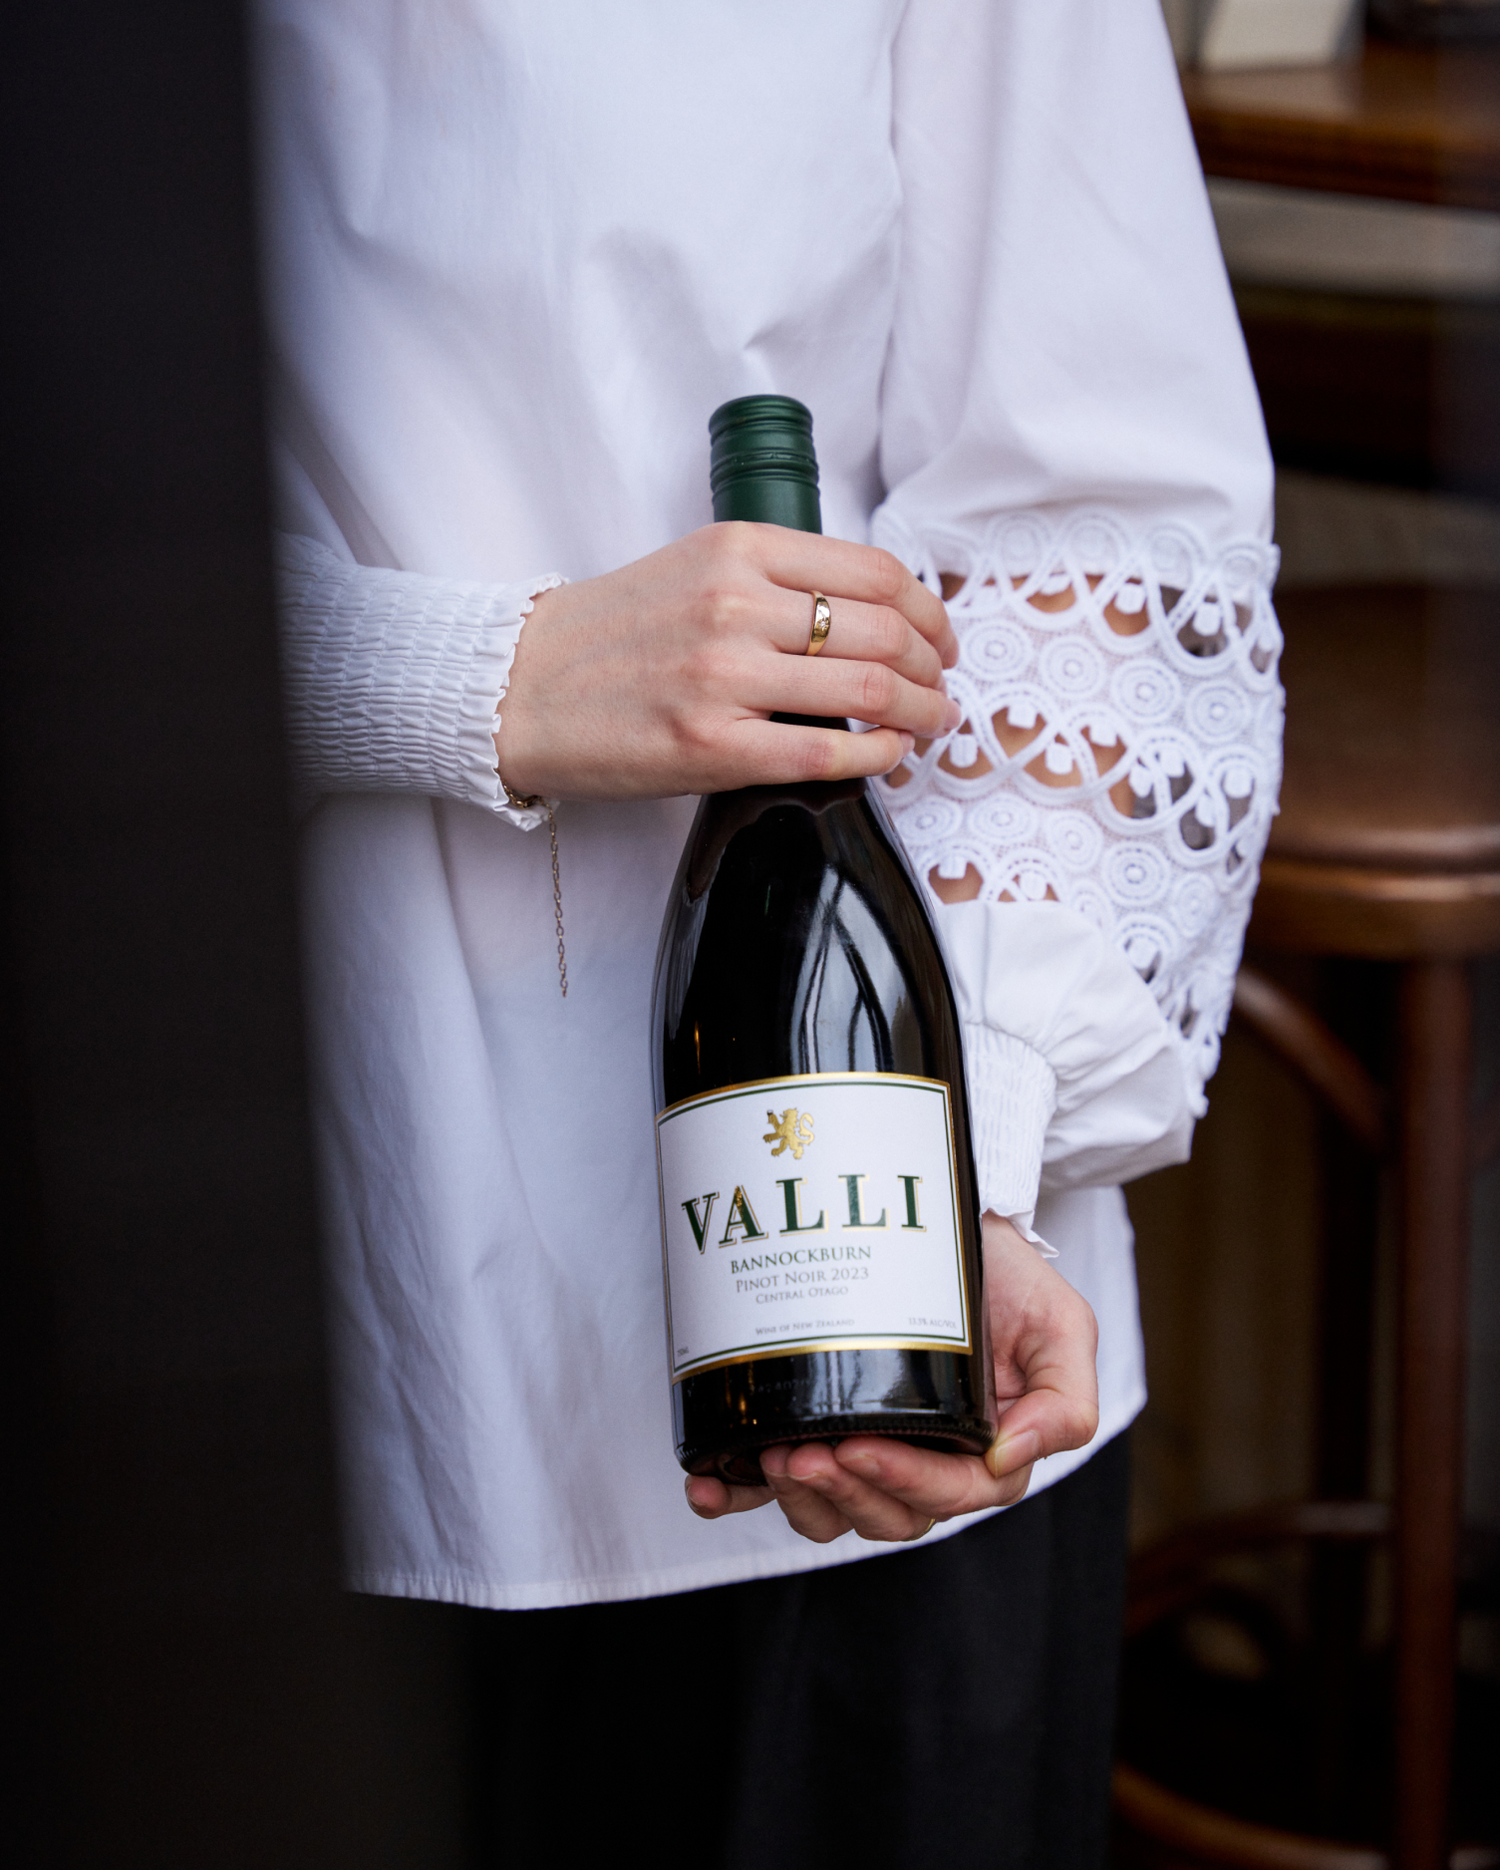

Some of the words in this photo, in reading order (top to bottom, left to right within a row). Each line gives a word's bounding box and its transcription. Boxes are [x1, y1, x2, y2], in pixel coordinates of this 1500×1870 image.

[681, 1174, 927, 1255] VALLI
[730, 1246, 871, 1274] BANNOCKBURN
[736, 1275, 779, 1293] PINOT
[785, 1271, 826, 1285] NOIR
[831, 1267, 869, 1281] 2023
[756, 1290, 804, 1304] CENTRAL
[808, 1286, 849, 1298] OTAGO
